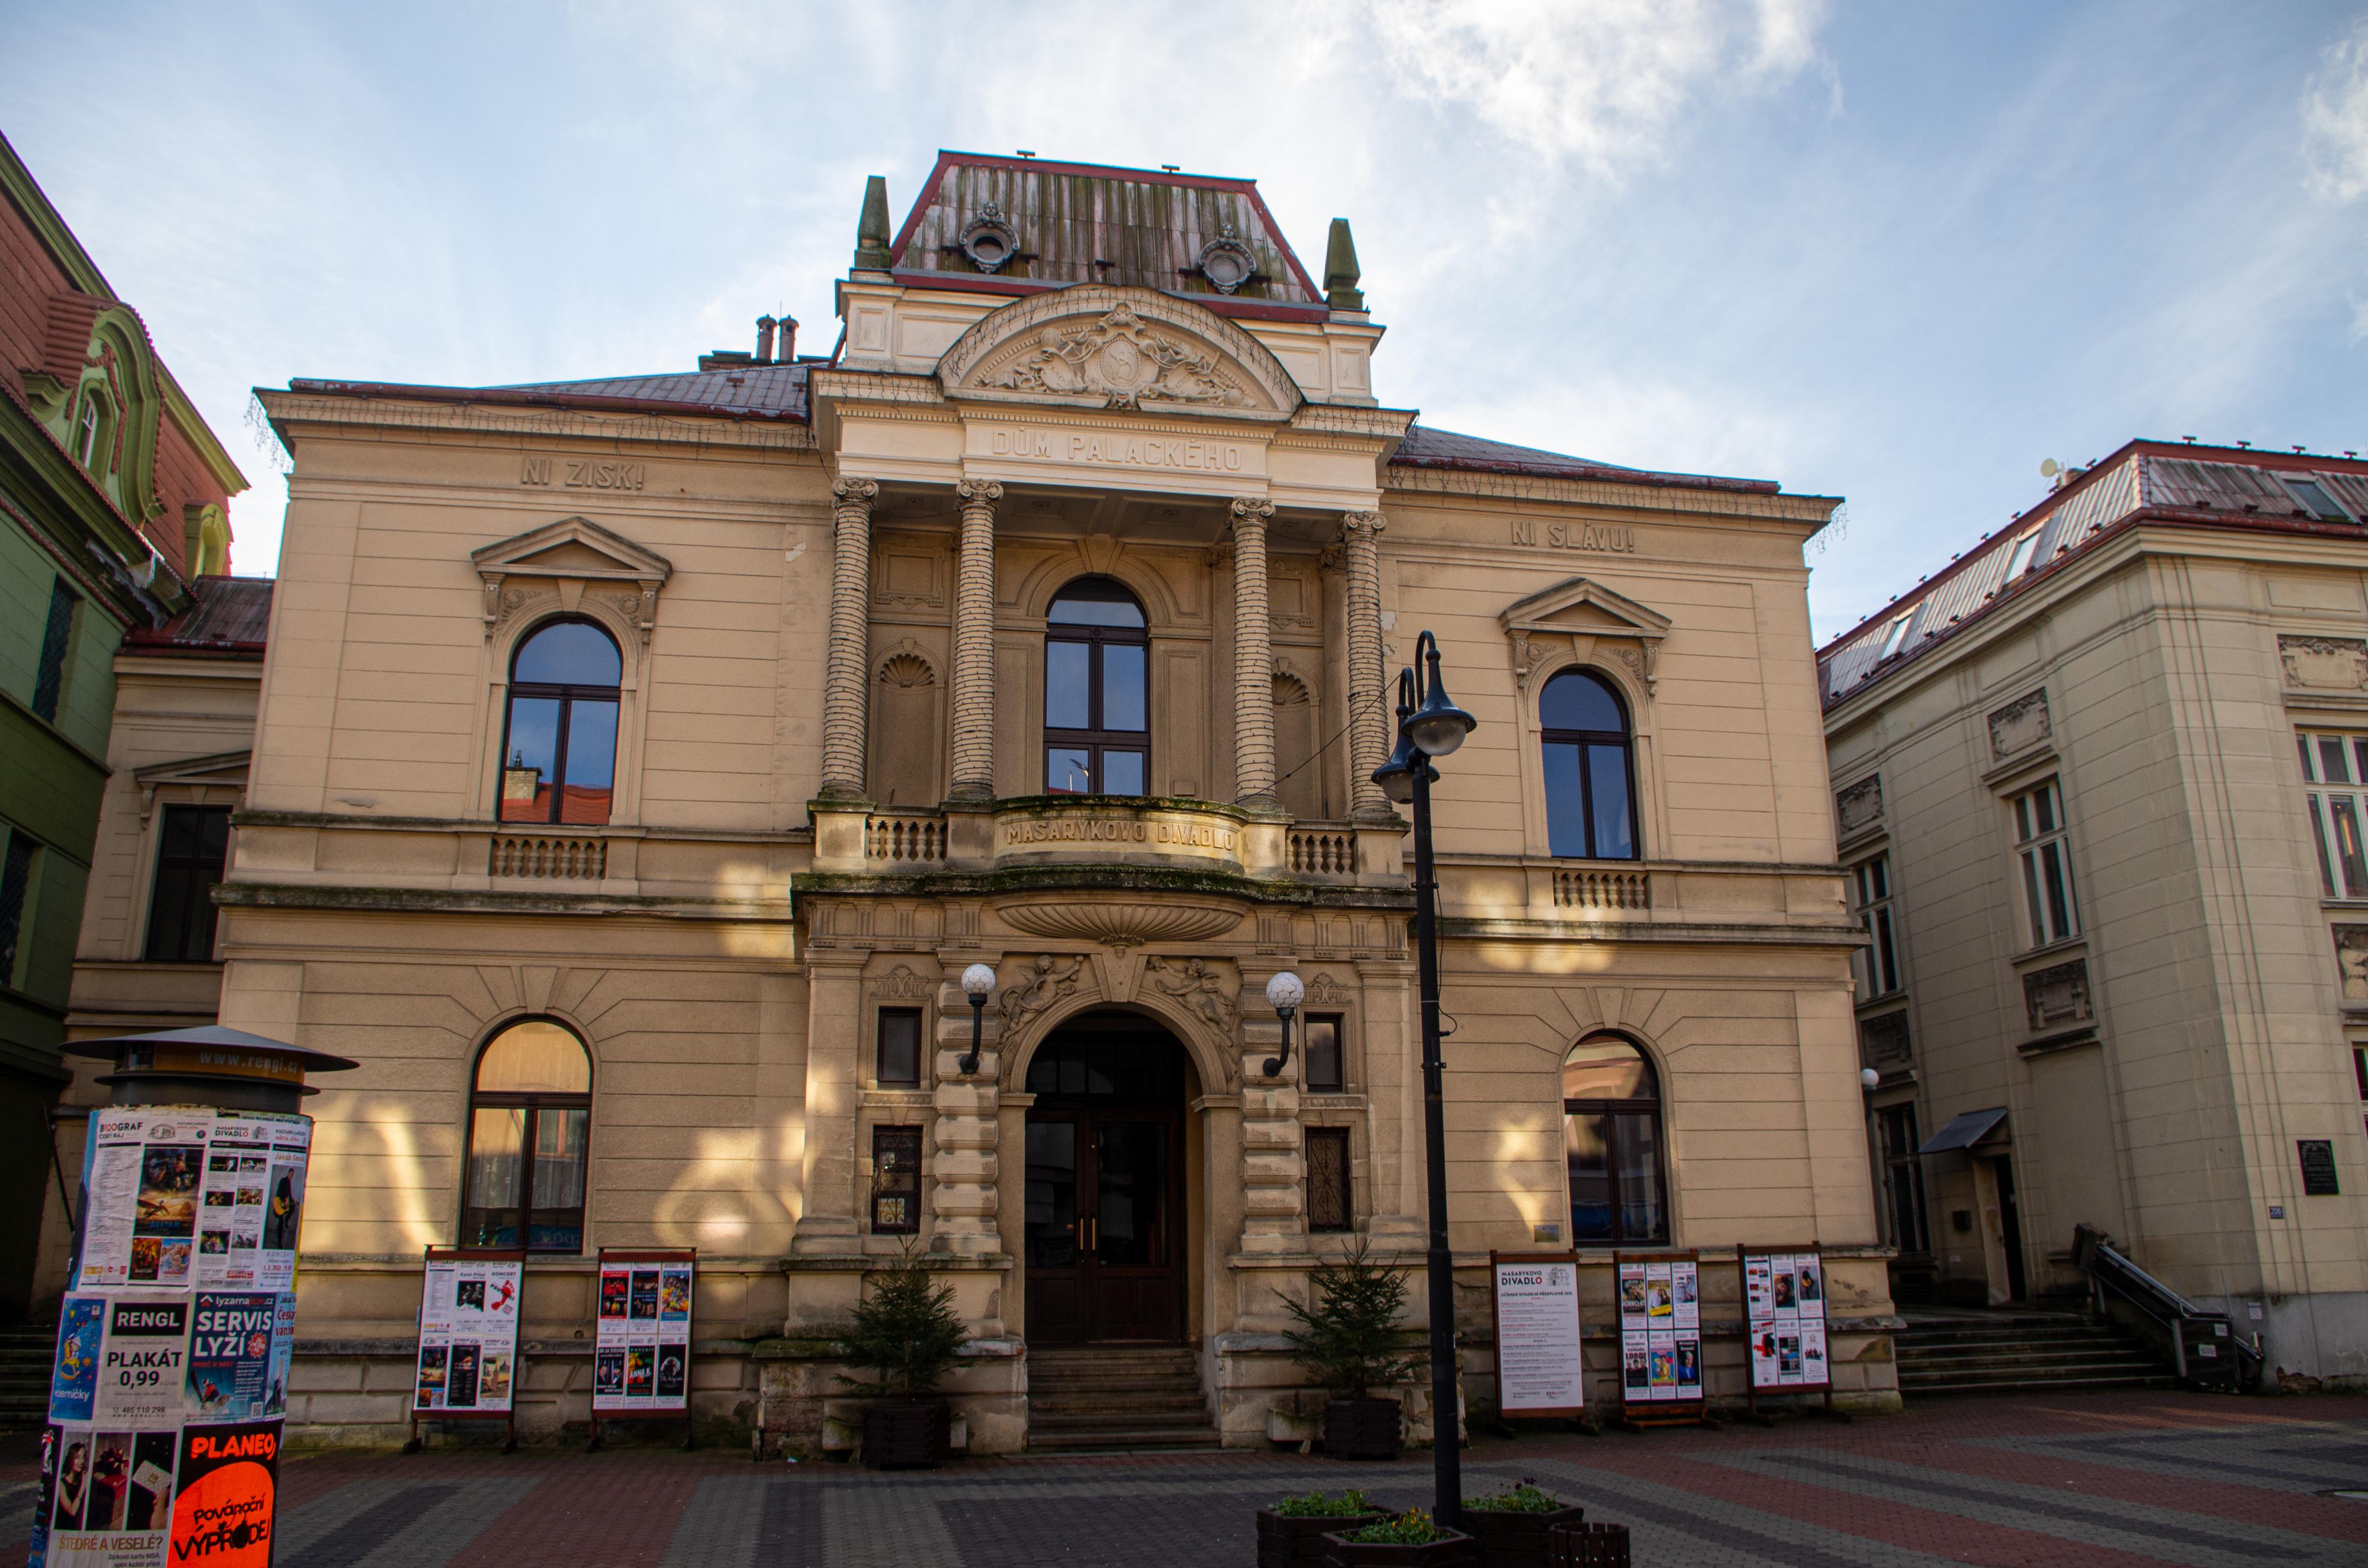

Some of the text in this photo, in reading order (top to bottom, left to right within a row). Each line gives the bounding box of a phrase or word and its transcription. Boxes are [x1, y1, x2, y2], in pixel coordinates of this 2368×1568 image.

[992, 427, 1241, 470] DŮM PALACKÉHO
[521, 458, 644, 490] NI ZISK!
[1511, 520, 1634, 552] NI SLÁVU!
[1008, 820, 1233, 851] MASARYKOVO DIVADLO
[1501, 1277, 1542, 1285] DIVADLO
[118, 1311, 180, 1328] RENGL
[197, 1311, 273, 1331] SERVIS
[194, 1331, 246, 1357] LYŽÍ
[107, 1348, 182, 1367] PLAKÁT
[120, 1370, 160, 1389] 0,99
[191, 1432, 276, 1460] PLANEO
[194, 1493, 265, 1525] Povánoční
[59, 1534, 98, 1550] ŠTĚDRÉ
[99, 1538, 108, 1550] A
[109, 1534, 163, 1550] VESELÉ?
